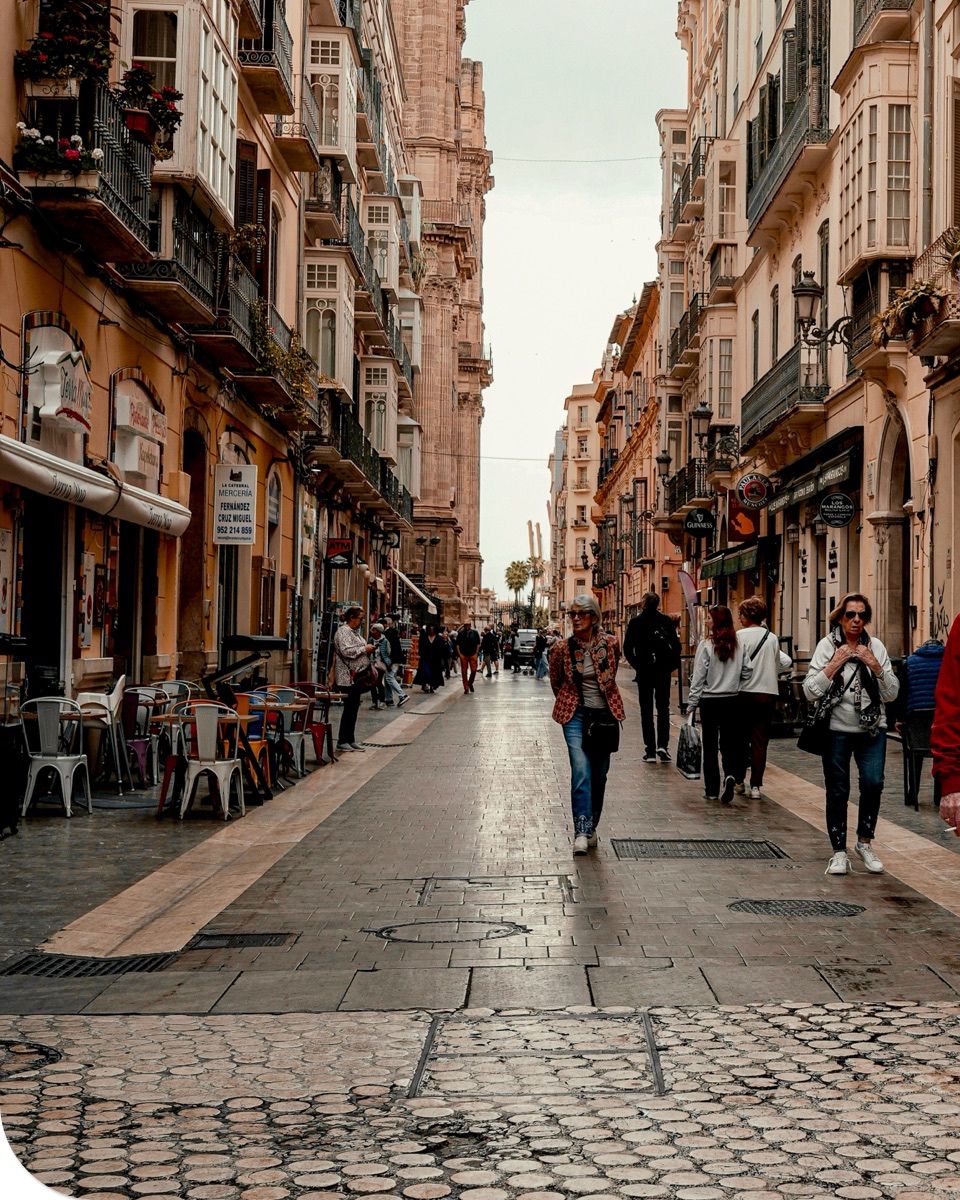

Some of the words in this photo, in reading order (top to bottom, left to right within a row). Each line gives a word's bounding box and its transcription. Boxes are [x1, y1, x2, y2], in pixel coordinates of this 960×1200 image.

[218, 489, 253, 497] MERCERÍA
[220, 500, 250, 511] FERNÁNDEZ
[218, 514, 232, 523] CRUZ
[233, 514, 252, 523] MIGUEL
[686, 521, 713, 529] GUINNESS
[216, 526, 228, 534] 952
[229, 526, 240, 534] 214
[241, 527, 252, 535] 859
[330, 542, 351, 550] ATM
